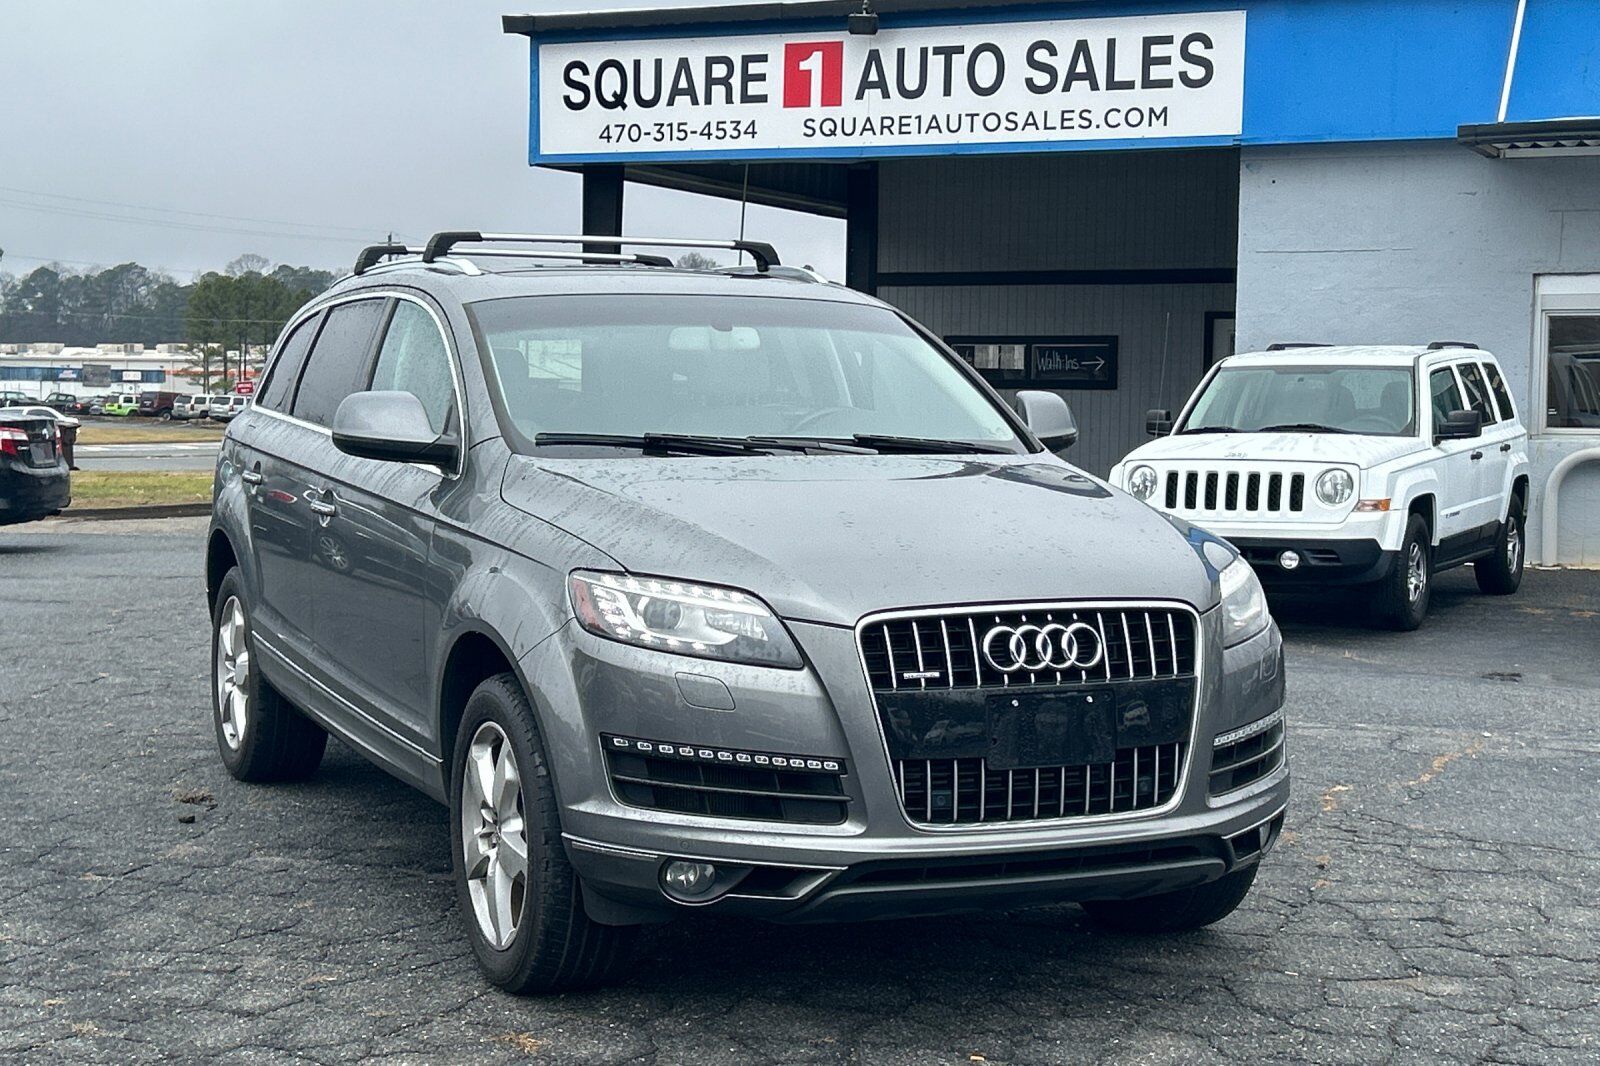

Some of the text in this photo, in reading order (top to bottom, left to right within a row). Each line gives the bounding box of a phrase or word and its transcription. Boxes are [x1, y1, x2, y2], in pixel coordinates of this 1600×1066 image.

[562, 53, 769, 111] SQUARE
[855, 42, 1006, 101] AUTO
[1024, 32, 1215, 95] SALES
[598, 119, 758, 143] 470-315-4534
[802, 106, 1169, 138] SQUARE1AUTOSALES.COM
